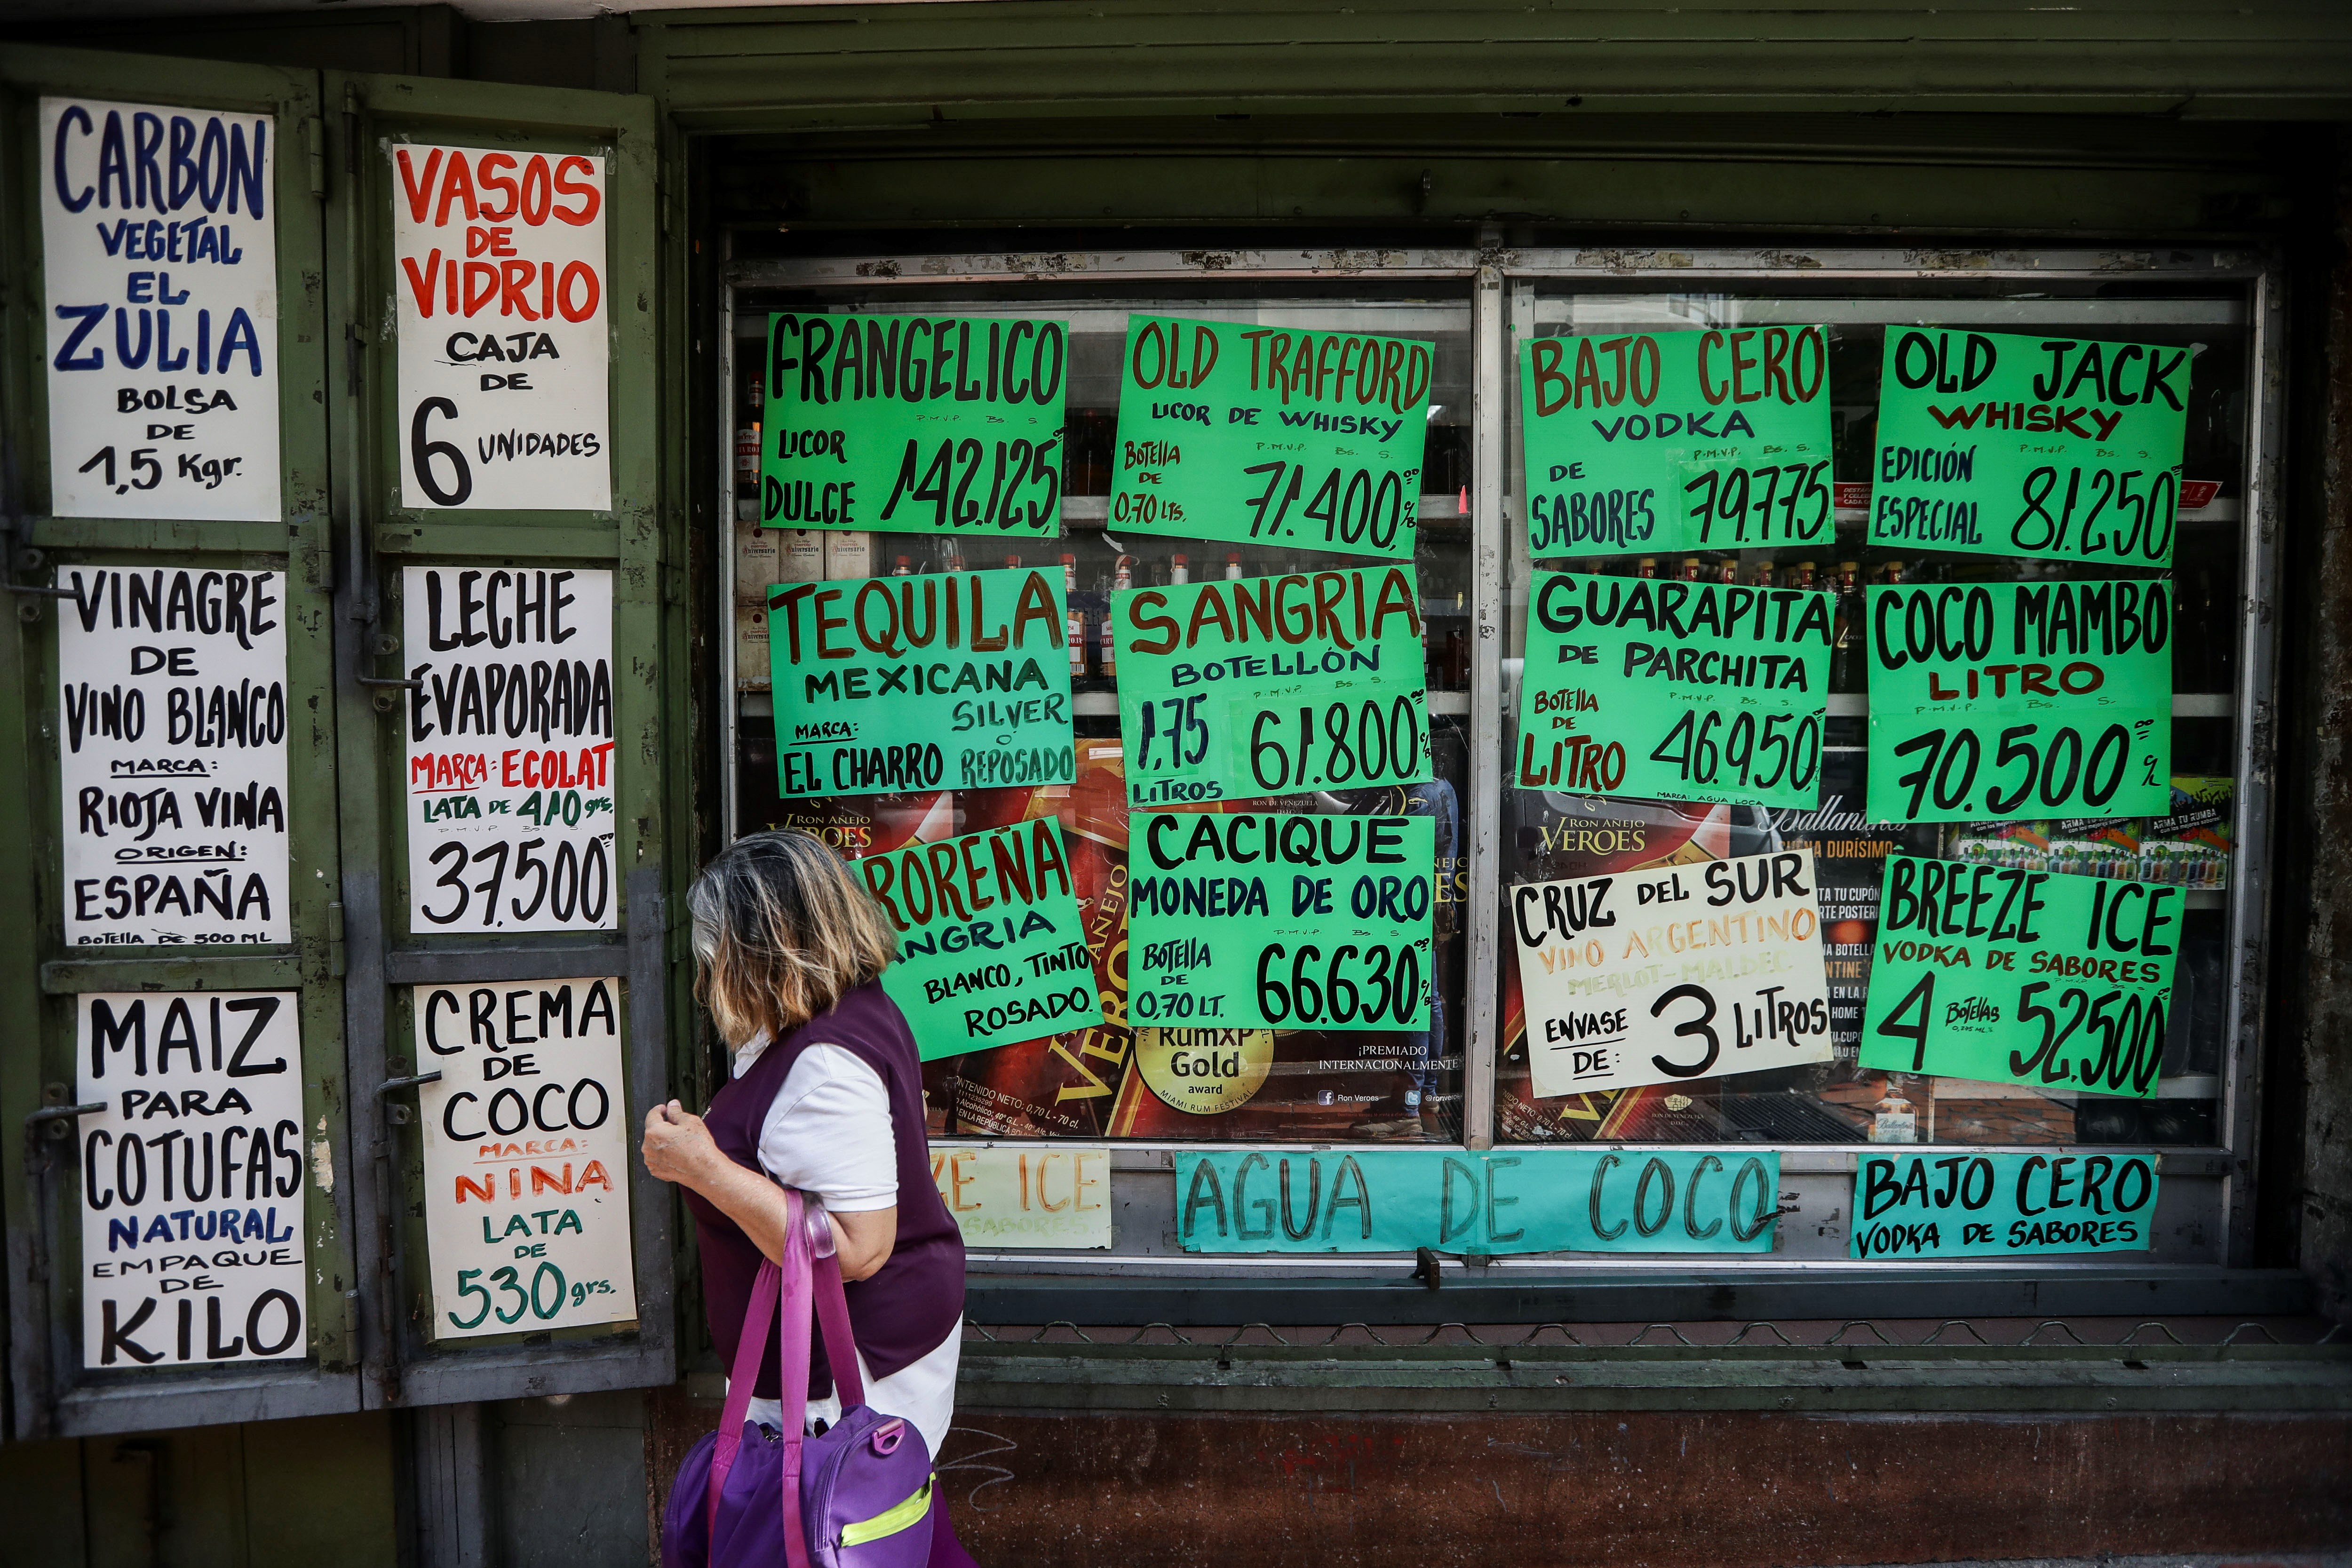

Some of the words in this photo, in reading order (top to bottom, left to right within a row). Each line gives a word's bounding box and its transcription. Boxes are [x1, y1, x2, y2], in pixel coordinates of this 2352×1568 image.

[55, 105, 265, 221] CARBON
[396, 148, 601, 227] VASOS
[96, 216, 243, 264] VEGETAL
[466, 226, 517, 258] DE
[127, 271, 191, 305] EL
[401, 248, 600, 323] VIDRIO
[53, 303, 262, 376] ZULIA
[446, 331, 559, 363] CAJA
[772, 314, 1063, 406] FRANGELICO
[480, 374, 533, 391] DE
[1133, 321, 1219, 391] OLD
[1241, 329, 1430, 414] TRAFFORD
[1532, 336, 1661, 418] BAJO
[1698, 326, 1825, 406] CERO
[1895, 331, 1997, 393] OLD
[2033, 341, 2186, 412] JACK
[117, 385, 238, 414] BOLSA
[146, 424, 196, 440] DE
[1152, 402, 1211, 426] LICOR
[1229, 407, 1262, 425] DE
[1279, 410, 1403, 442] WHISKY
[1592, 410, 1755, 442] VODKA
[1927, 402, 2122, 442] WHISKY
[411, 397, 472, 506] 6
[478, 428, 601, 464] UNIDADES
[778, 429, 847, 464] LICOR
[1881, 441, 1977, 483] EDICIÓN
[79, 446, 162, 495] 1,5
[178, 453, 243, 490] Kgr.
[1138, 471, 1163, 485] DE
[1549, 462, 1586, 482] DE
[765, 475, 856, 523] DULCE
[1114, 492, 1157, 525] 0,70
[1531, 488, 1655, 550] SABORES
[1875, 495, 1982, 545] ESPECIAL
[71, 570, 277, 650] VINAGRE
[426, 570, 577, 651] LECHE
[768, 571, 1064, 666] TEQUILA
[1129, 568, 1421, 655] SANGRIA
[1537, 574, 1833, 645] GUARAPITA
[1875, 586, 1994, 670] COCO
[2014, 581, 2169, 658] MAMBO
[131, 646, 199, 676] DE
[805, 658, 1049, 703] MEXICANA
[1171, 645, 1381, 687] BOTELLÓN
[1558, 645, 1599, 664] DE
[1623, 642, 1808, 692] PARCHITA
[1929, 661, 2105, 701] LITRO
[64, 682, 144, 753] VINO
[168, 678, 285, 748] BLANCO
[410, 659, 612, 744] EVAPORADA
[952, 692, 1069, 731] SILVER
[1551, 716, 1577, 729] DE
[795, 721, 858, 740] MARCA:
[1138, 692, 1209, 771] 1,75
[111, 758, 218, 773] MARCA:
[502, 741, 614, 790] ECOLAT
[783, 751, 822, 795] EL
[832, 741, 944, 790] CHARRO
[961, 745, 1073, 788] REPOSADO
[1520, 732, 1626, 792] LITRO
[79, 786, 183, 841] RIOJA
[423, 796, 481, 823] LATA
[489, 799, 511, 813] DE
[1657, 791, 1691, 800] MARCA:
[1697, 795, 1728, 804] AGUA
[827, 814, 870, 824] AÑEJO
[1538, 817, 1645, 856] VEROES
[1569, 819, 1599, 828] RON
[1604, 818, 1645, 828] AÑEJO
[2178, 815, 2188, 824] TU
[115, 841, 247, 860] ORIGEN:
[1147, 815, 1411, 870] CACIQUE
[75, 868, 270, 921] ESPAÑA
[1130, 875, 1269, 918] MONEDA
[1292, 875, 1334, 918] DE
[1351, 875, 1429, 923] ORO
[1515, 877, 1616, 948] CRUZ
[1637, 873, 1689, 906] DEL
[1705, 853, 1811, 907] SUR
[1835, 888, 1847, 901] TU
[1886, 857, 2050, 943] BREEZE
[2087, 880, 2176, 957] ICE
[158, 932, 187, 944] DE
[195, 933, 235, 944] 500
[241, 931, 272, 944] ML
[1537, 939, 1604, 975] VINO
[1622, 907, 1816, 962] ARGENTINO
[1023, 941, 1089, 978] TINTO
[1160, 974, 1189, 986] DE
[1884, 940, 1971, 968] VODKA
[1986, 949, 2016, 971] DE
[2029, 950, 2161, 984] SABORES
[1136, 991, 1194, 1020] 0,70
[1832, 1007, 1858, 1019] HOME
[1834, 987, 1845, 999] EN
[1848, 987, 1859, 999] LA
[91, 996, 287, 1079] MAIZ
[426, 982, 615, 1055] CREMA
[1545, 1008, 1629, 1043] ENVASE
[1651, 983, 1720, 1078] 3
[1877, 971, 1936, 1071] 4
[483, 1054, 540, 1081] DE
[1171, 1051, 1239, 1077] Gold
[1359, 1046, 1427, 1056] ¡PREMIADO
[1573, 1050, 1621, 1075] DE:
[122, 1087, 253, 1120] PARA
[443, 1078, 610, 1141] COCO
[1160, 1090, 1187, 1108] MIAMI
[1215, 1090, 1254, 1111] FESTIVAL
[1188, 1084, 1222, 1094] award
[959, 1108, 967, 1118] EN
[967, 1112, 976, 1122] LA
[1026, 1104, 1045, 1117] 0,70
[1058, 1115, 1069, 1124] 70
[86, 1119, 302, 1210] COTUFAS
[480, 1138, 587, 1158] MARCA:
[455, 1160, 614, 1204] NINA
[1019, 1152, 1102, 1212] ICE
[1184, 1153, 1372, 1242] AGUA
[1440, 1156, 1526, 1244] DE
[1589, 1154, 1772, 1243] COCO
[1863, 1156, 1994, 1222] BAJO
[2016, 1155, 2153, 1217] CERO
[109, 1207, 294, 1252] NATURAL
[483, 1209, 583, 1243] LATA
[1857, 1222, 1940, 1259] VODKA
[1963, 1223, 1995, 1245] DE
[2007, 1220, 2138, 1249] SABORES
[93, 1248, 302, 1277] EMPAQUE
[515, 1243, 547, 1259] DE
[160, 1275, 224, 1294] DE
[448, 1261, 566, 1329] 530
[572, 1277, 617, 1307] grs.
[101, 1288, 301, 1365] KILO
